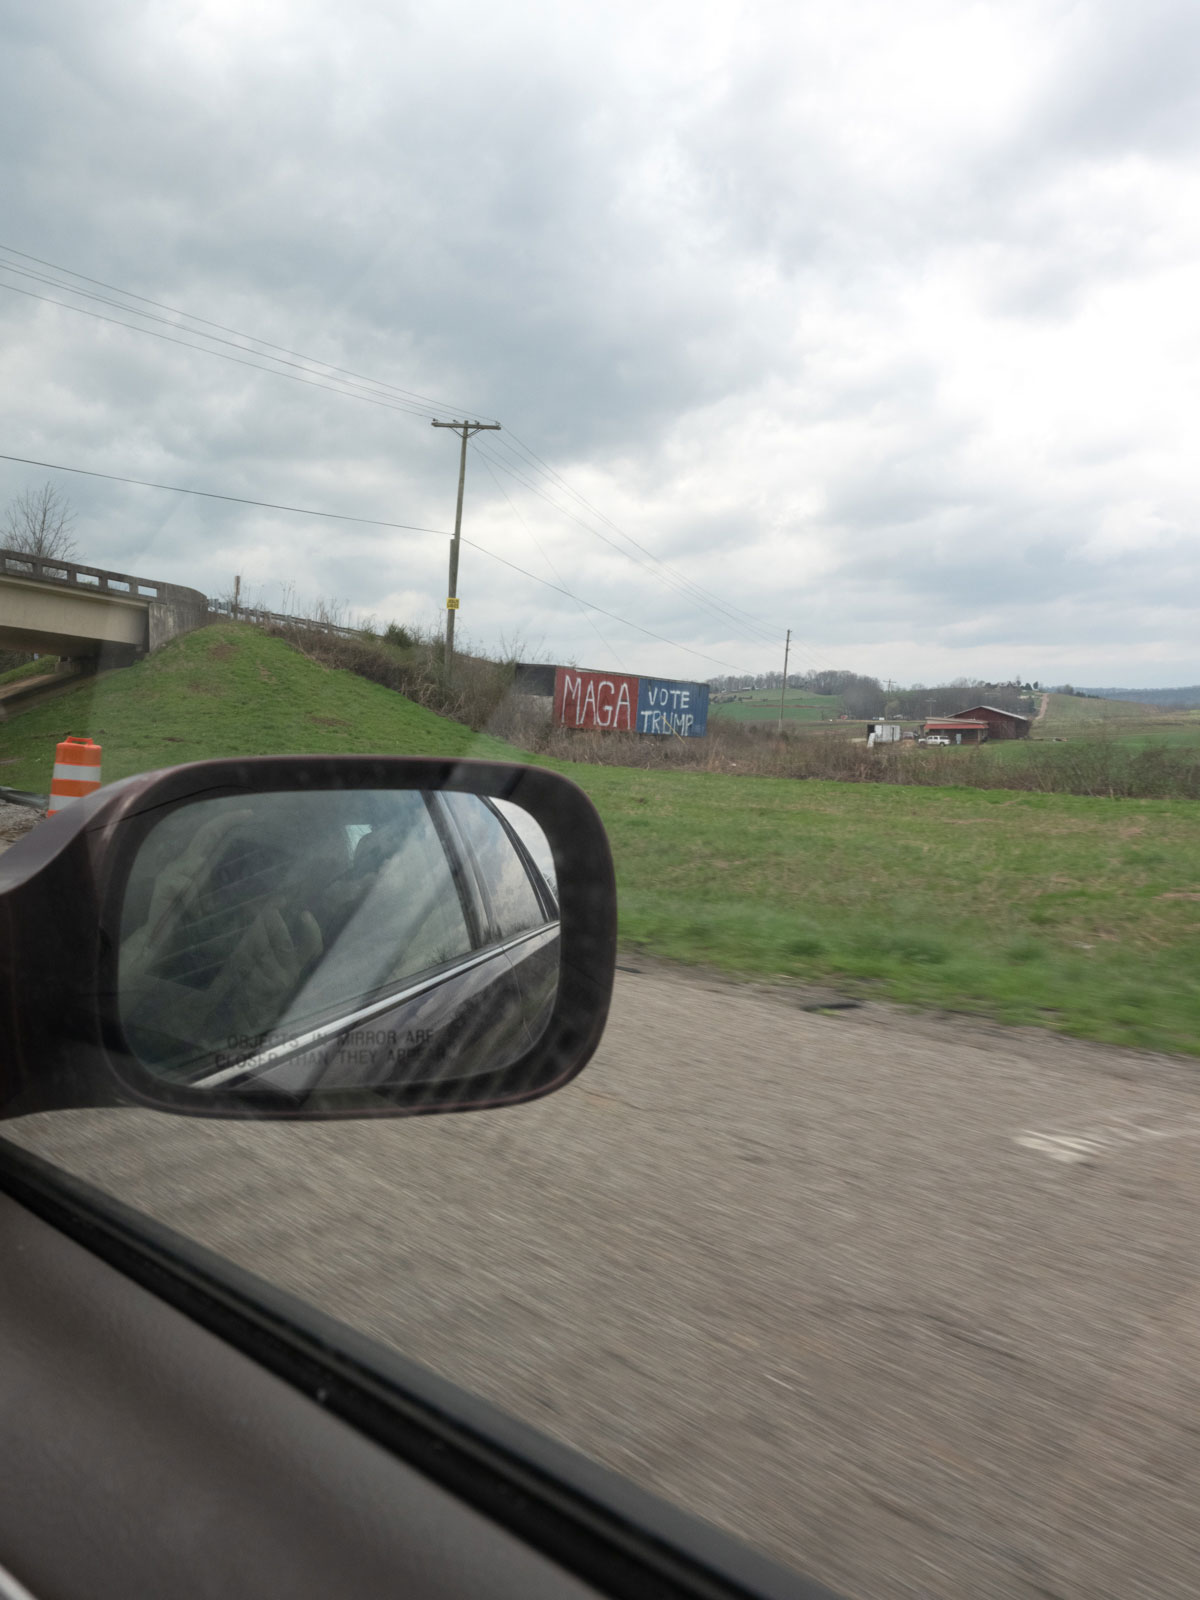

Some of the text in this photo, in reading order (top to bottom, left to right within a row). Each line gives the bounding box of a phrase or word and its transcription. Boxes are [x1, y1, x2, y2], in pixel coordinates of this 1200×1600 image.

[561, 675, 630, 730] MAGA
[648, 686, 690, 709] VOTE
[641, 710, 694, 736] TRUMP
[227, 1033, 299, 1050] OBJECTS
[336, 1029, 397, 1045] MIRROR
[406, 1028, 434, 1044] ARE
[215, 1046, 448, 1069] CLOSER THAN THEY APR
